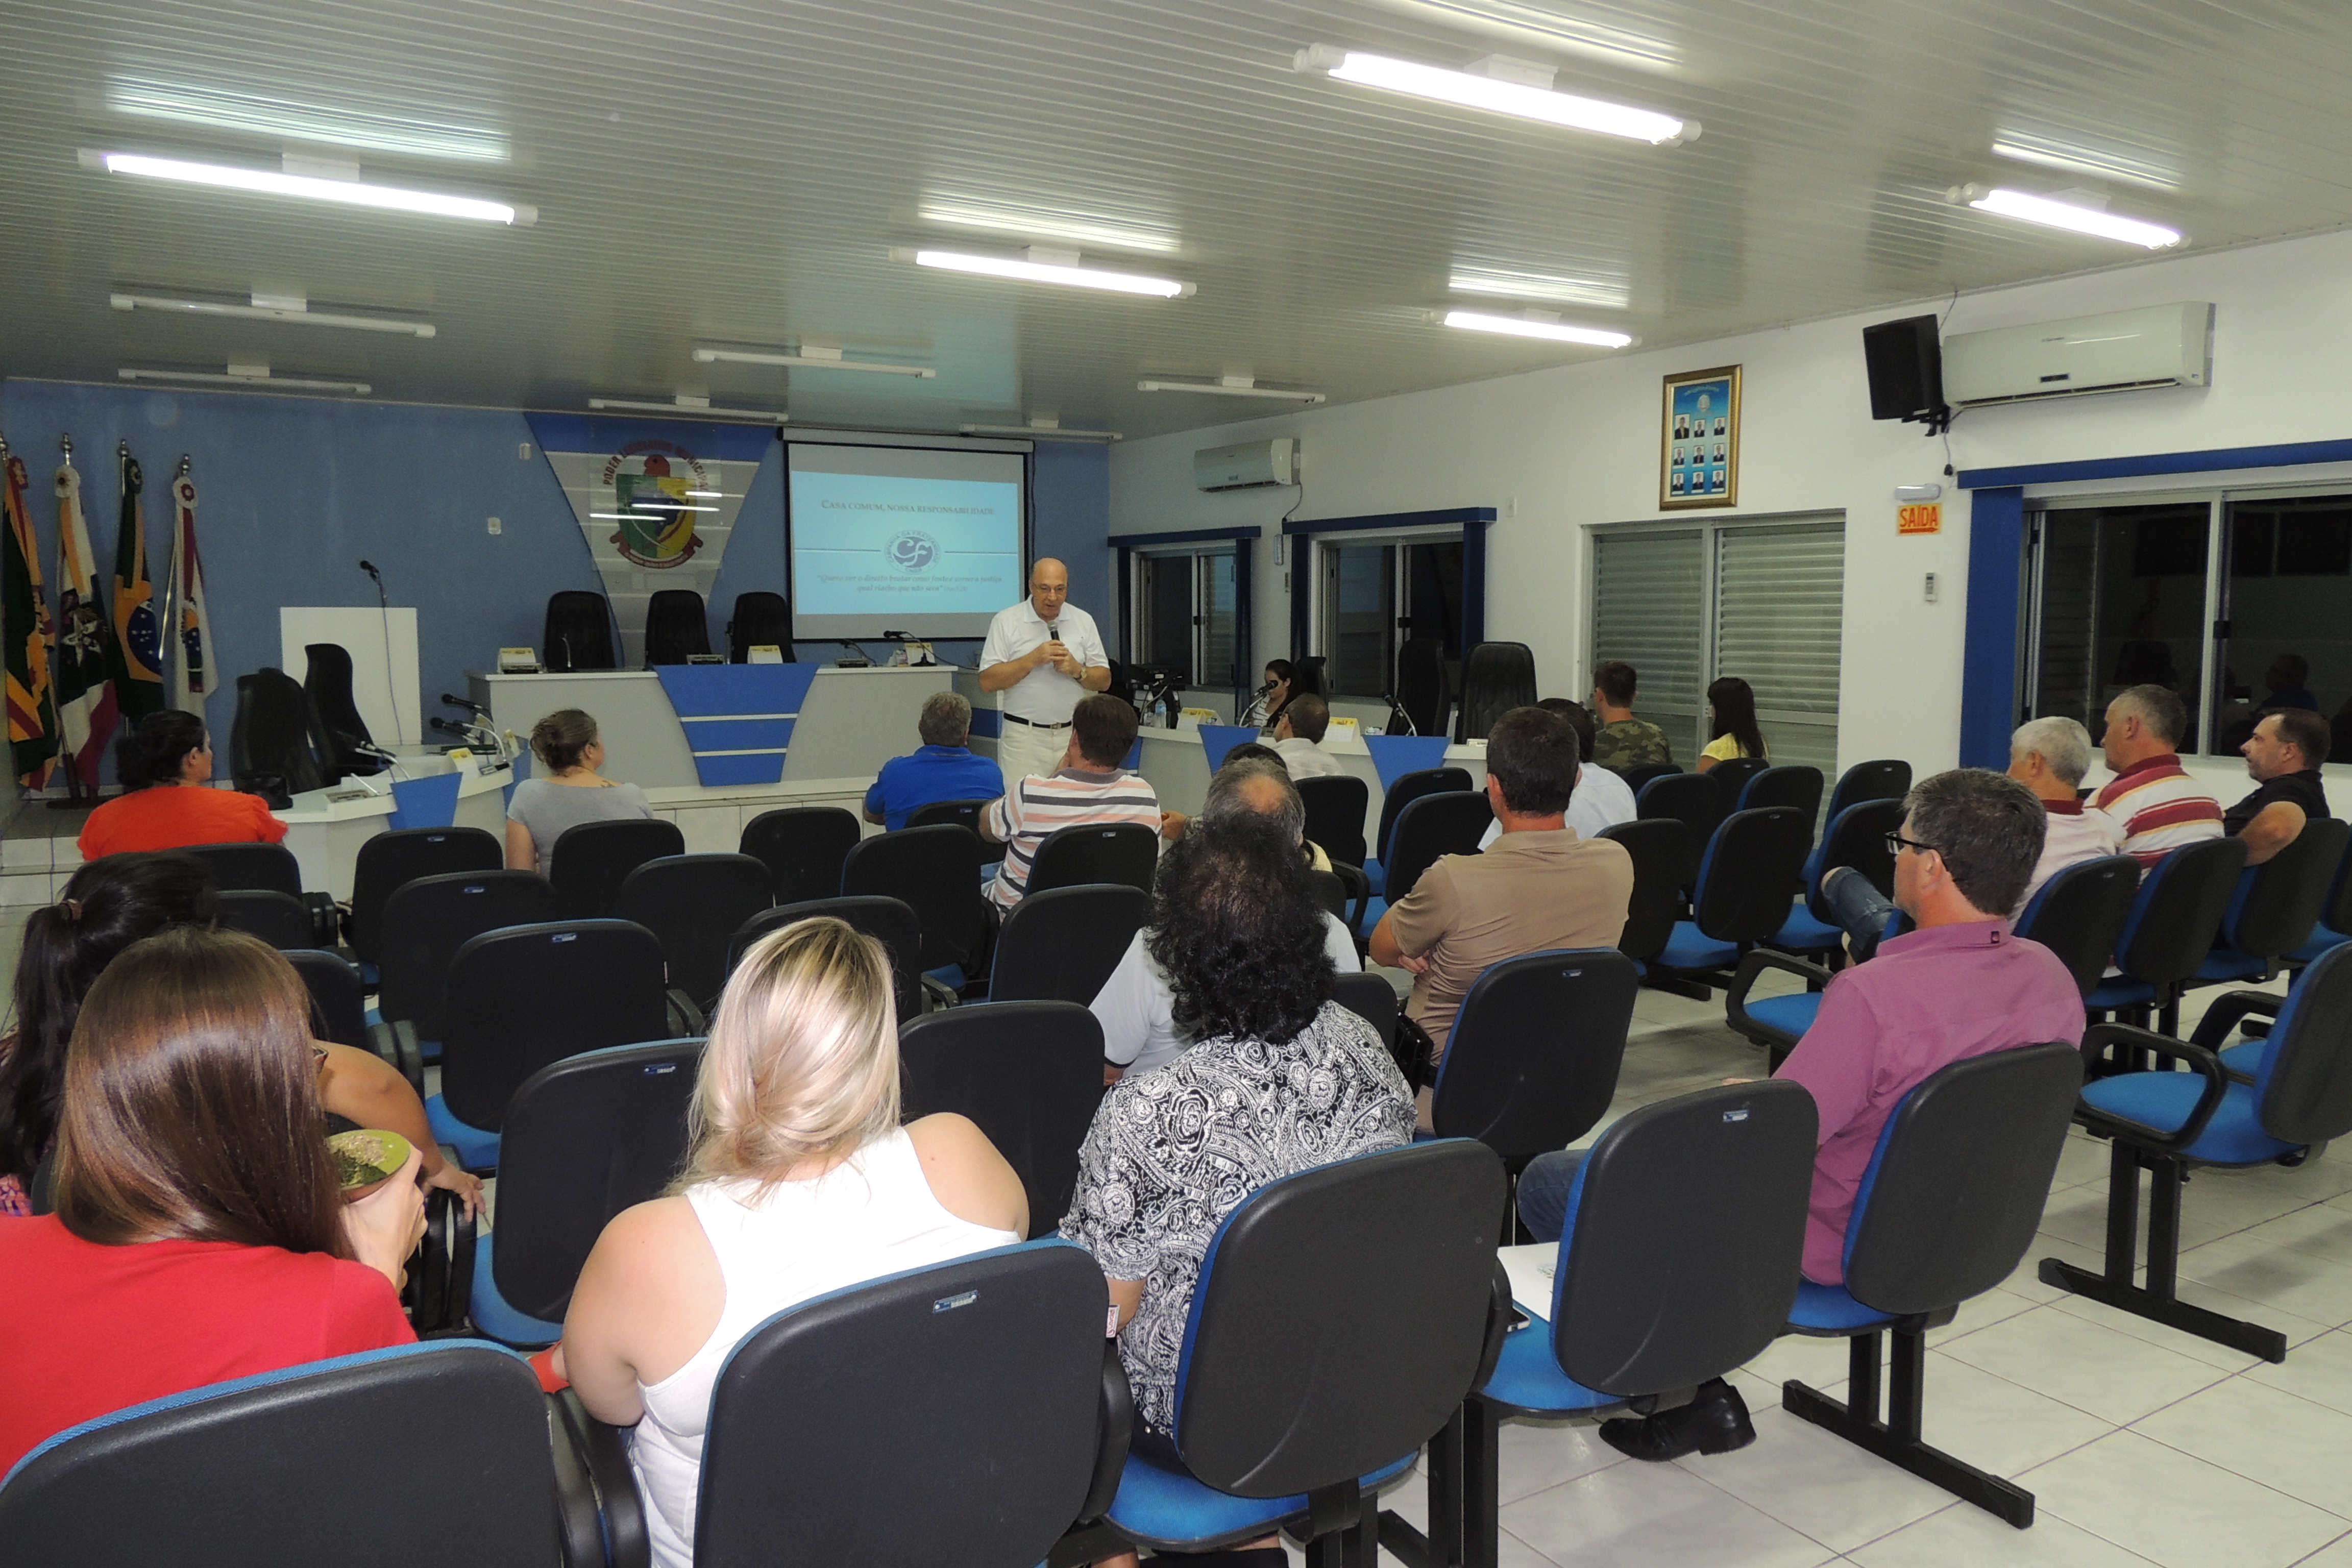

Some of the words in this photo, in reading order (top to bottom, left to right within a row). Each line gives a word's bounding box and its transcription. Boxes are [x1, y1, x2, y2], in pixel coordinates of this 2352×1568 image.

[603, 456, 622, 485] PODER
[887, 504, 915, 512] NOSSA
[917, 505, 994, 515] RESPONSABILIDADE
[1899, 505, 1938, 527] SAÍDA
[979, 575, 1002, 584] justiça
[856, 584, 873, 593] qual
